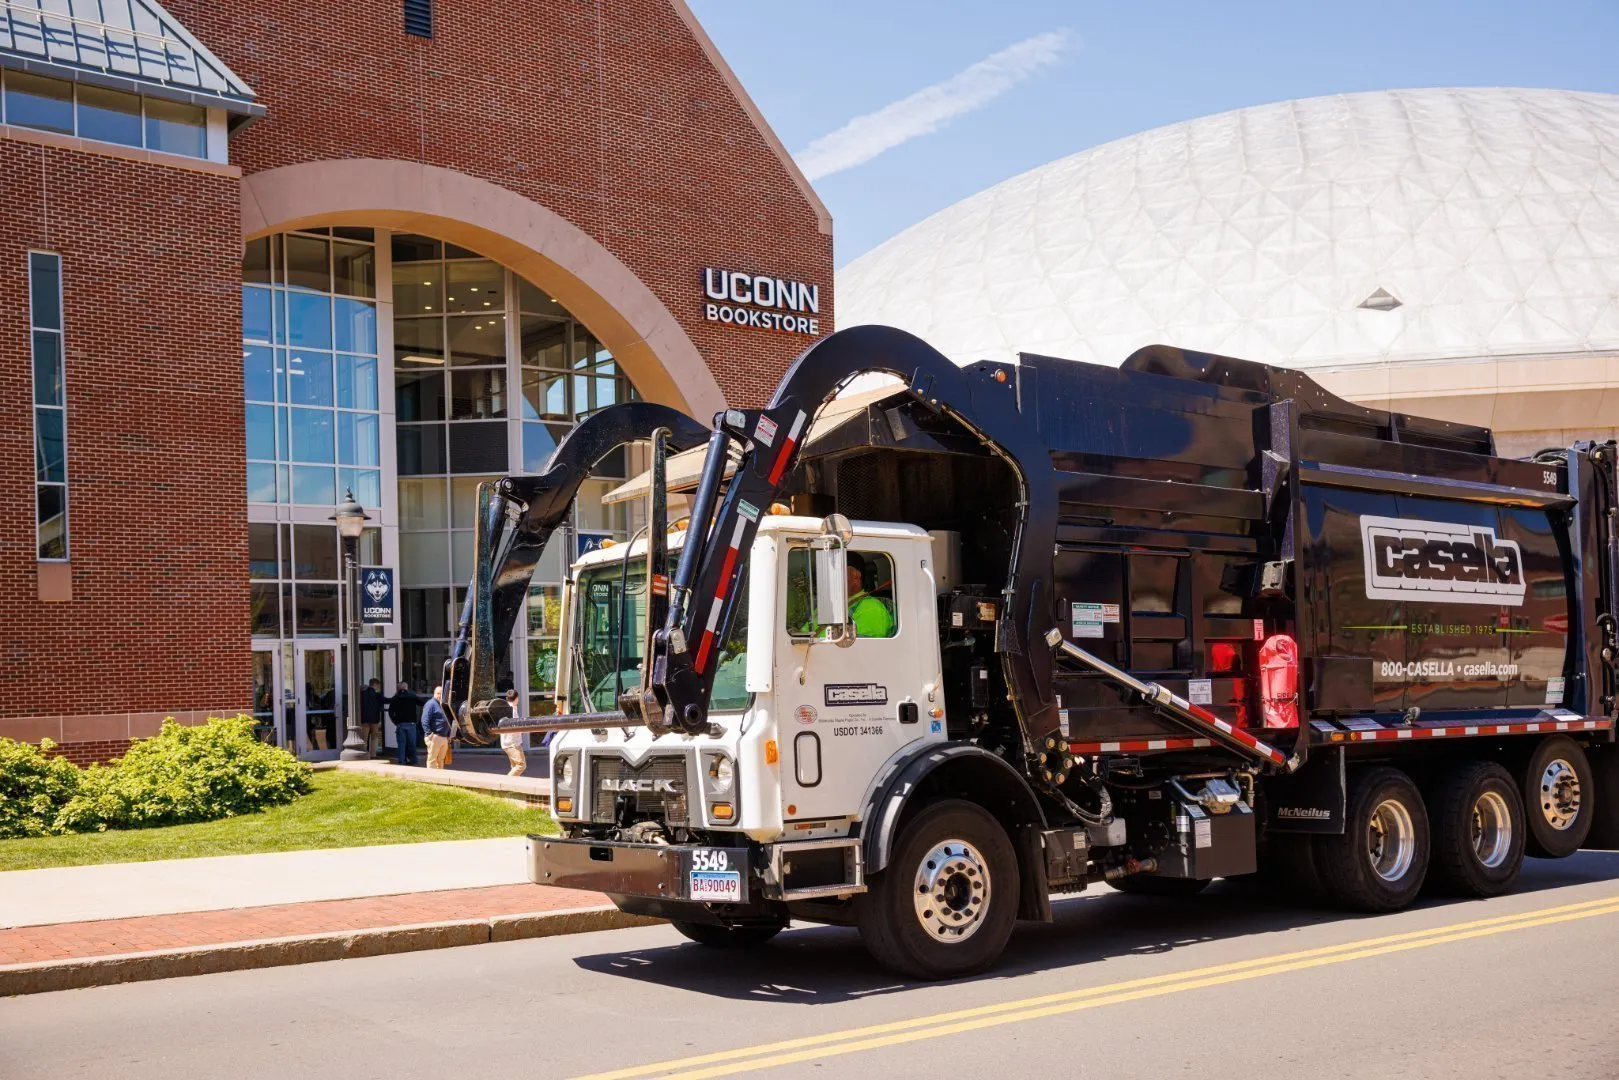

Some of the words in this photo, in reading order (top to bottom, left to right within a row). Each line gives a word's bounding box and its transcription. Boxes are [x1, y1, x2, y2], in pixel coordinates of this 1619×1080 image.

[705, 267, 819, 314] UCONN
[706, 304, 819, 335] BOOKSTORE
[1543, 471, 1557, 485] 5549
[1411, 623, 1471, 634] ESTABLISHED
[1475, 625, 1493, 635] 1975
[1381, 661, 1454, 677] 800-CASELLA
[1463, 662, 1518, 677] casella.com
[833, 727, 858, 737] USDOT
[602, 778, 677, 793] MACK
[1278, 807, 1331, 818] McNeilus
[692, 850, 728, 871] 5549
